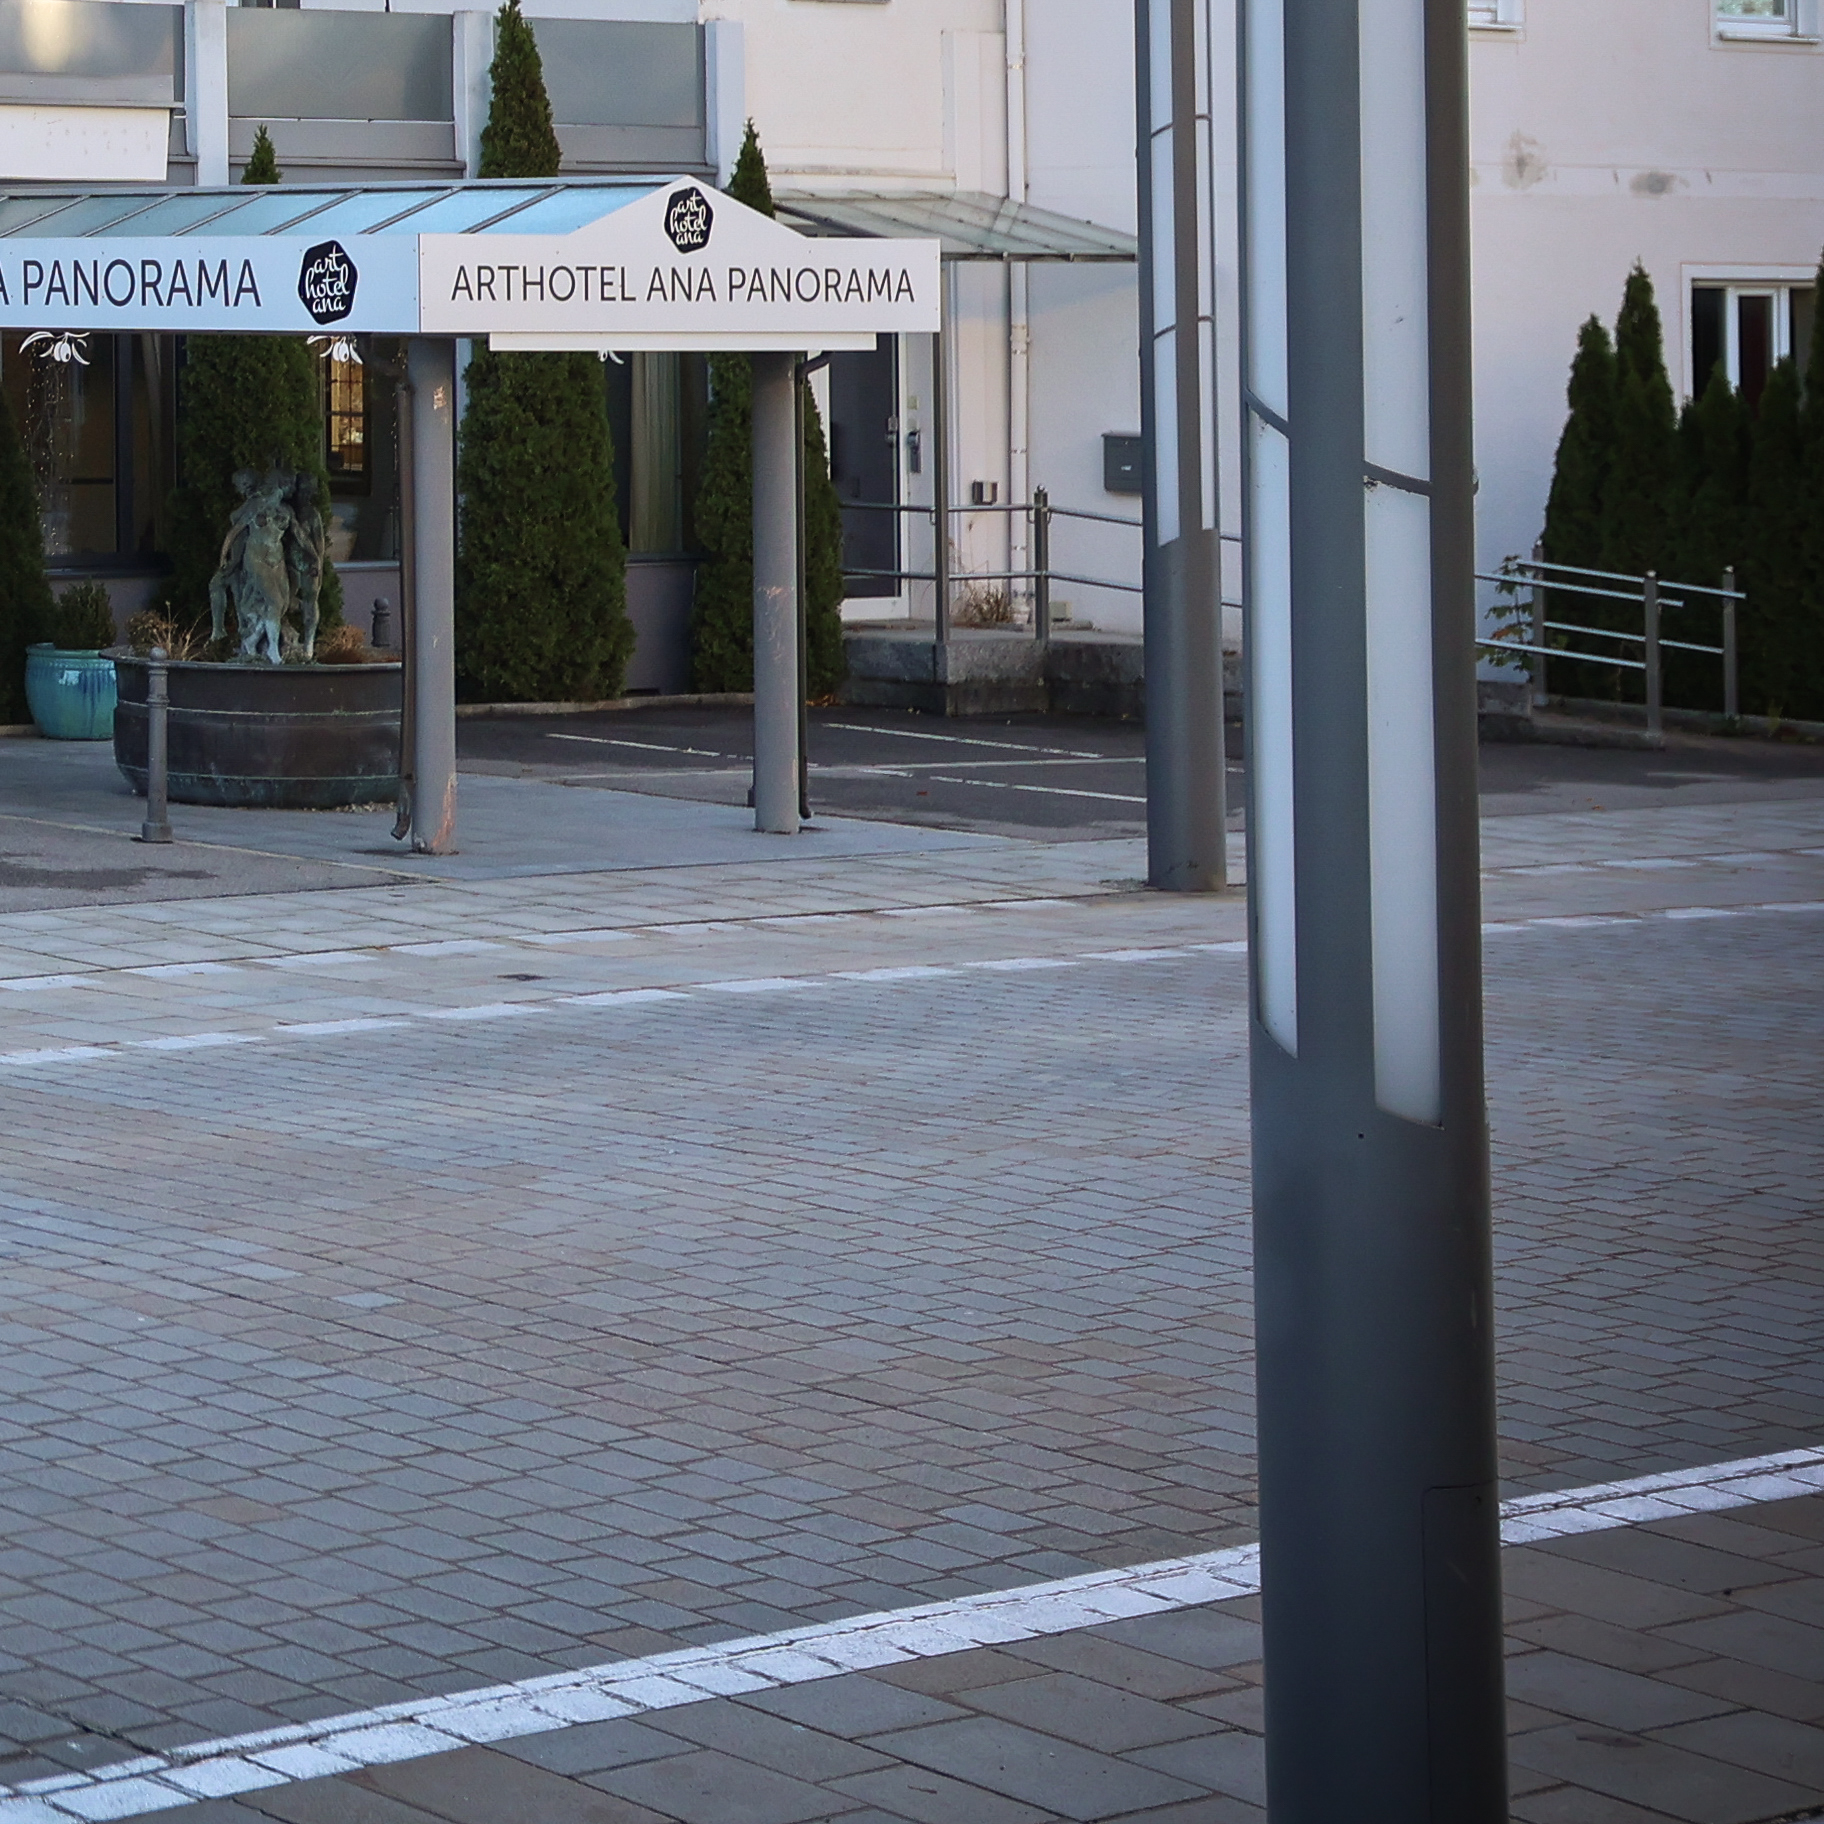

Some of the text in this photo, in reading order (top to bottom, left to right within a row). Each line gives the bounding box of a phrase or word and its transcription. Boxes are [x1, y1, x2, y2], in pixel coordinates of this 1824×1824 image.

[677, 190, 702, 213] art
[670, 204, 708, 234] hotel
[676, 231, 704, 246] ana
[314, 244, 344, 274] art
[22, 259, 262, 307] PANORAMA
[305, 263, 350, 299] hotel
[451, 265, 916, 303] ARTHOTEL ANA PANORAMA
[312, 297, 346, 314] ana
